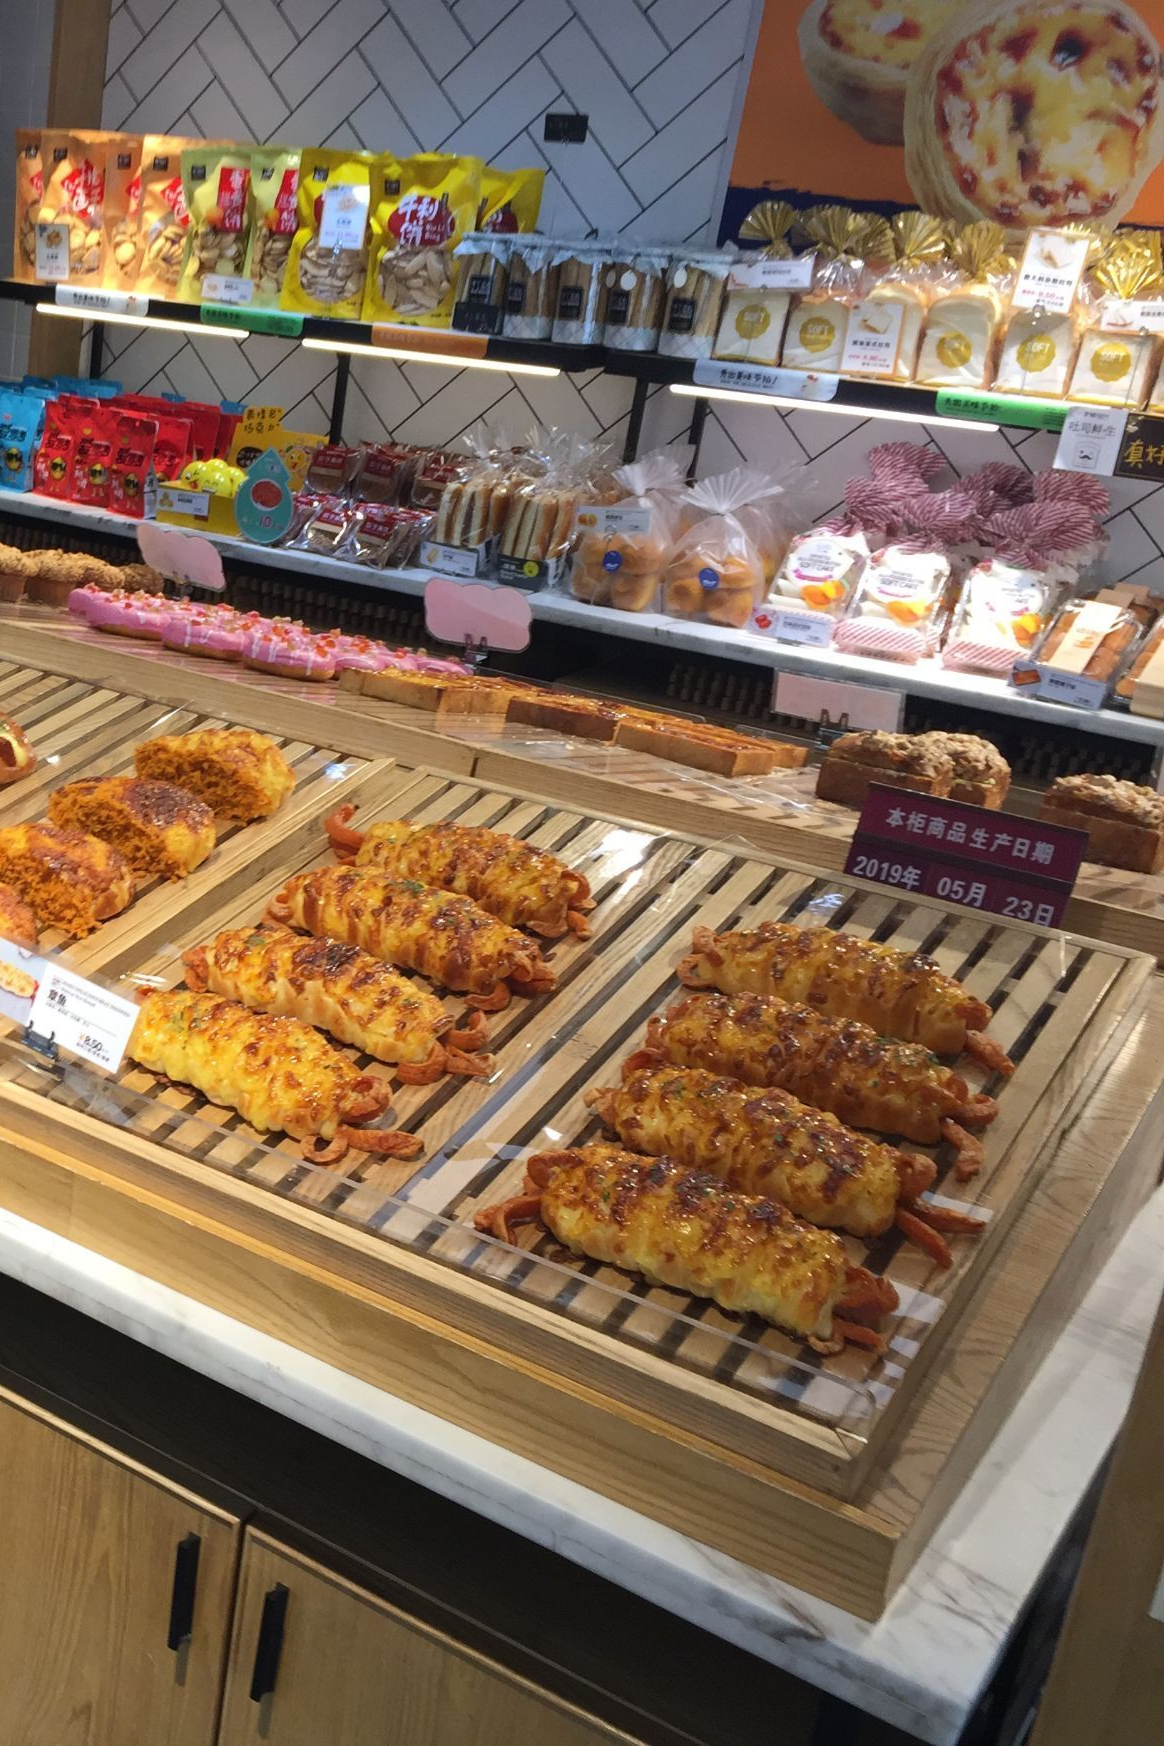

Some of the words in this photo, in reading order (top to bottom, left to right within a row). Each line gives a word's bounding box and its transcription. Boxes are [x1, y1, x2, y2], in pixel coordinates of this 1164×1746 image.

[886, 807, 1055, 865] 本柜商品生产日期
[853, 855, 922, 890] 2019年
[936, 876, 987, 908] 05月
[1003, 896, 1055, 928] 23日
